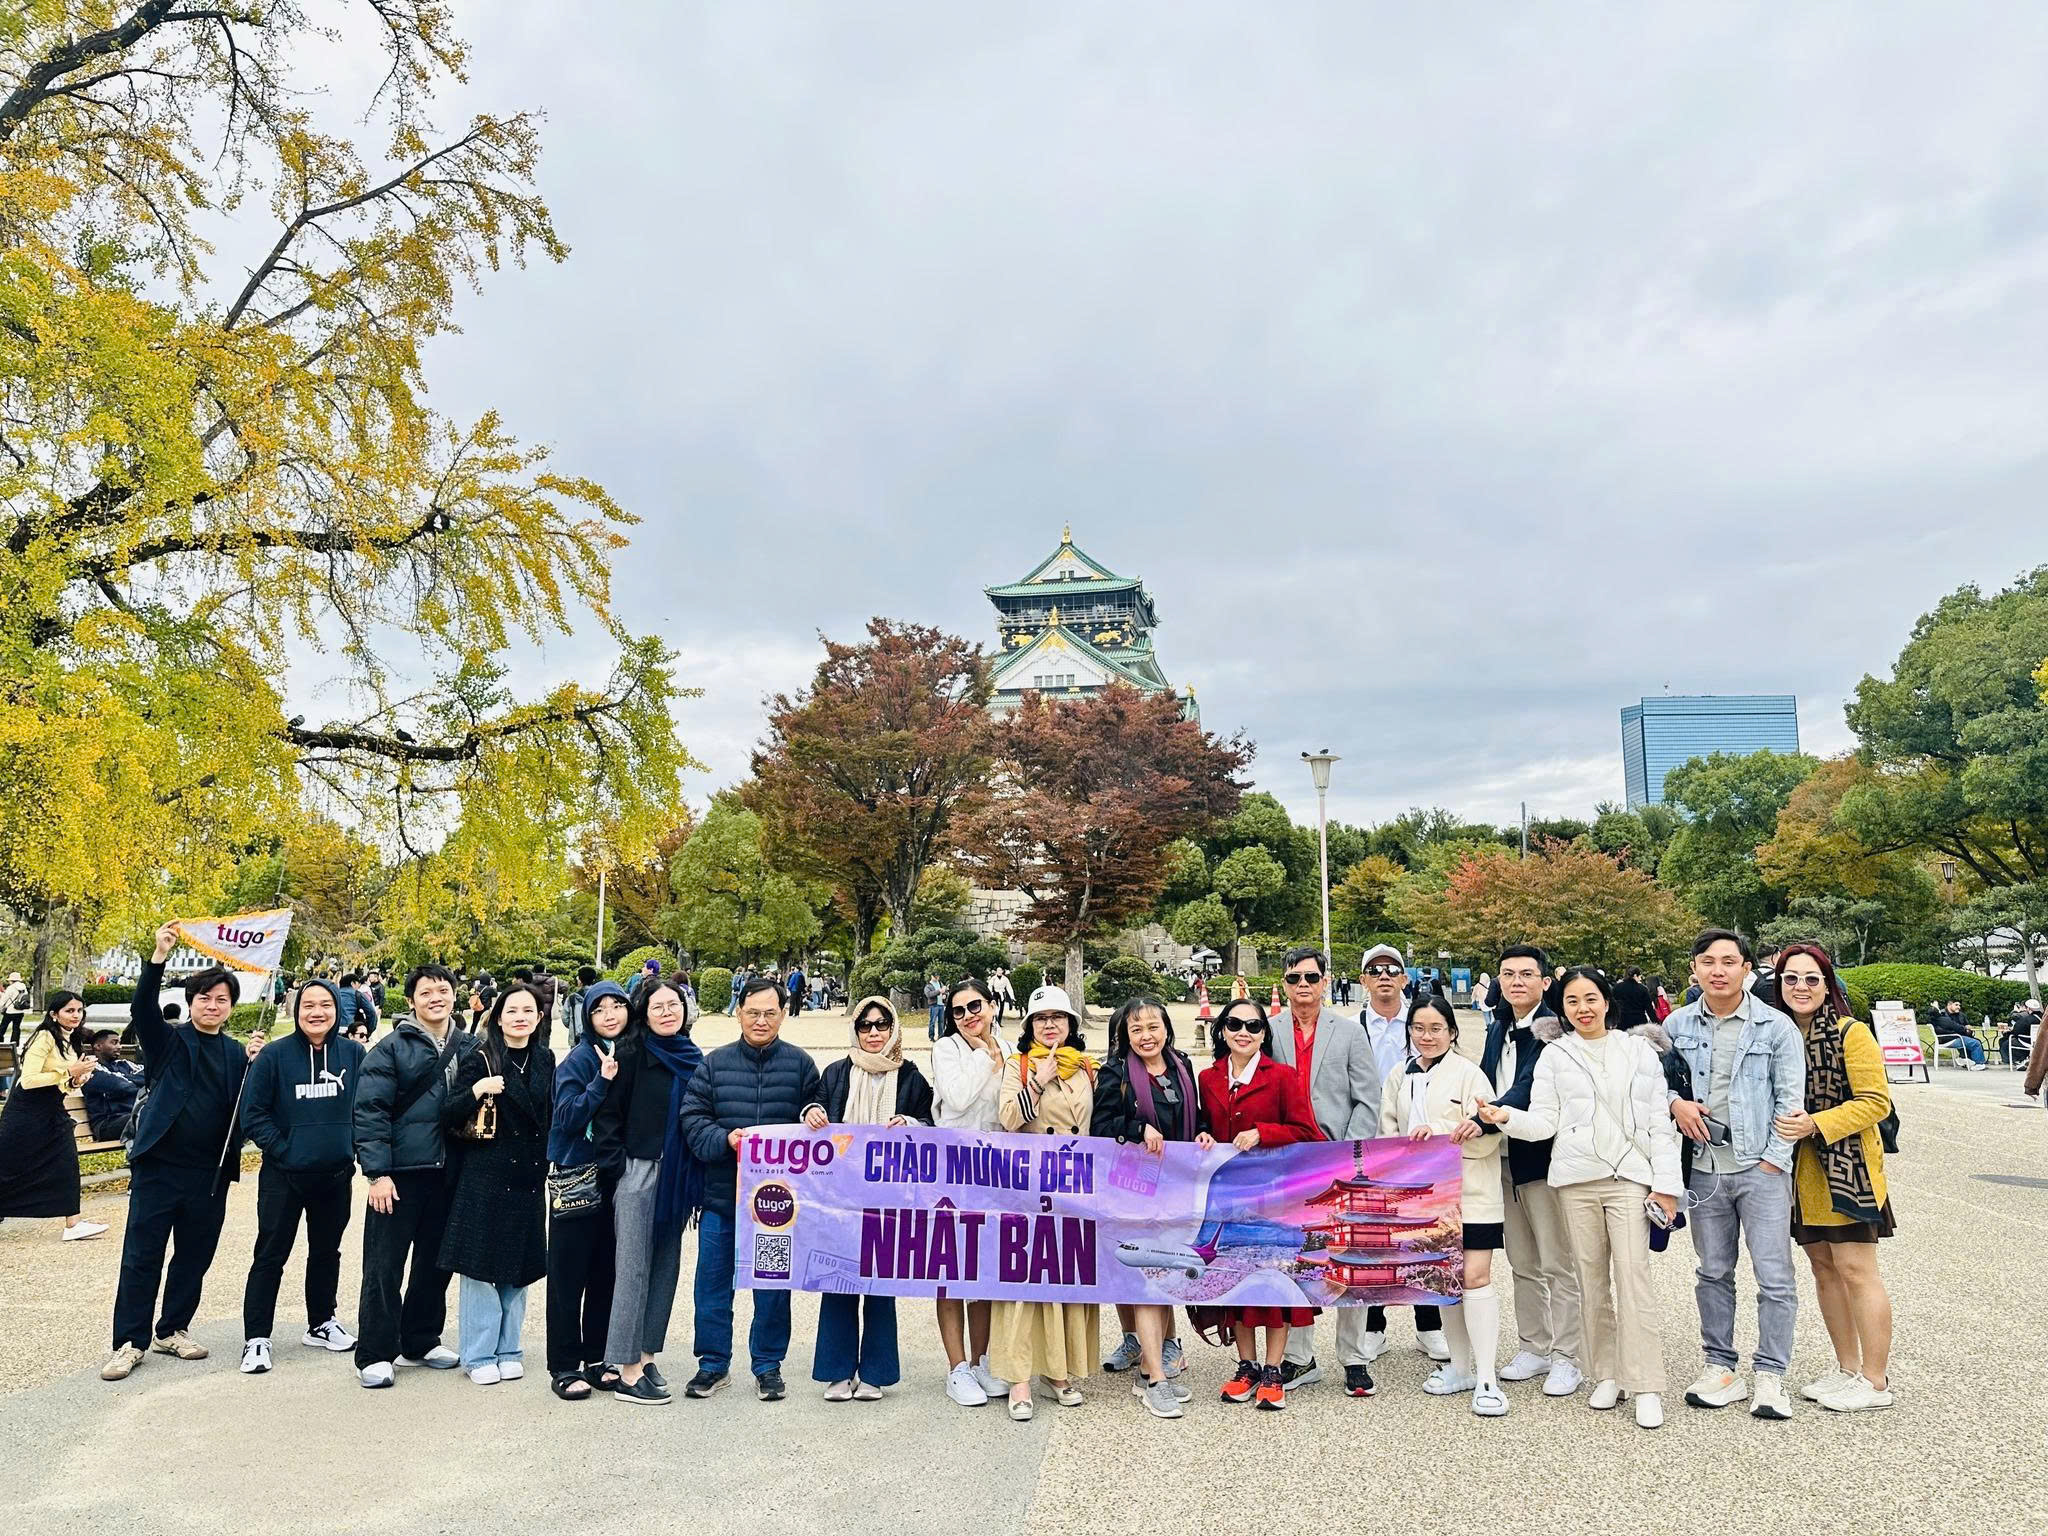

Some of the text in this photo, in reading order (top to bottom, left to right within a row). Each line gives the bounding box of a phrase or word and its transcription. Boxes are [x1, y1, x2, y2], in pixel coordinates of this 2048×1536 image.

[217, 924, 265, 949] tugo
[295, 1082, 338, 1099] PUMA
[748, 1133, 834, 1174] tugo
[864, 1135, 1094, 1194] CHÀO MỪNG ĐẾN
[1117, 1175, 1149, 1193] TUGO
[560, 1199, 590, 1209] CHANEL
[757, 1197, 786, 1212] tugo
[860, 1196, 1096, 1299] NHẬT BẢN
[813, 1254, 837, 1268] TUGO
